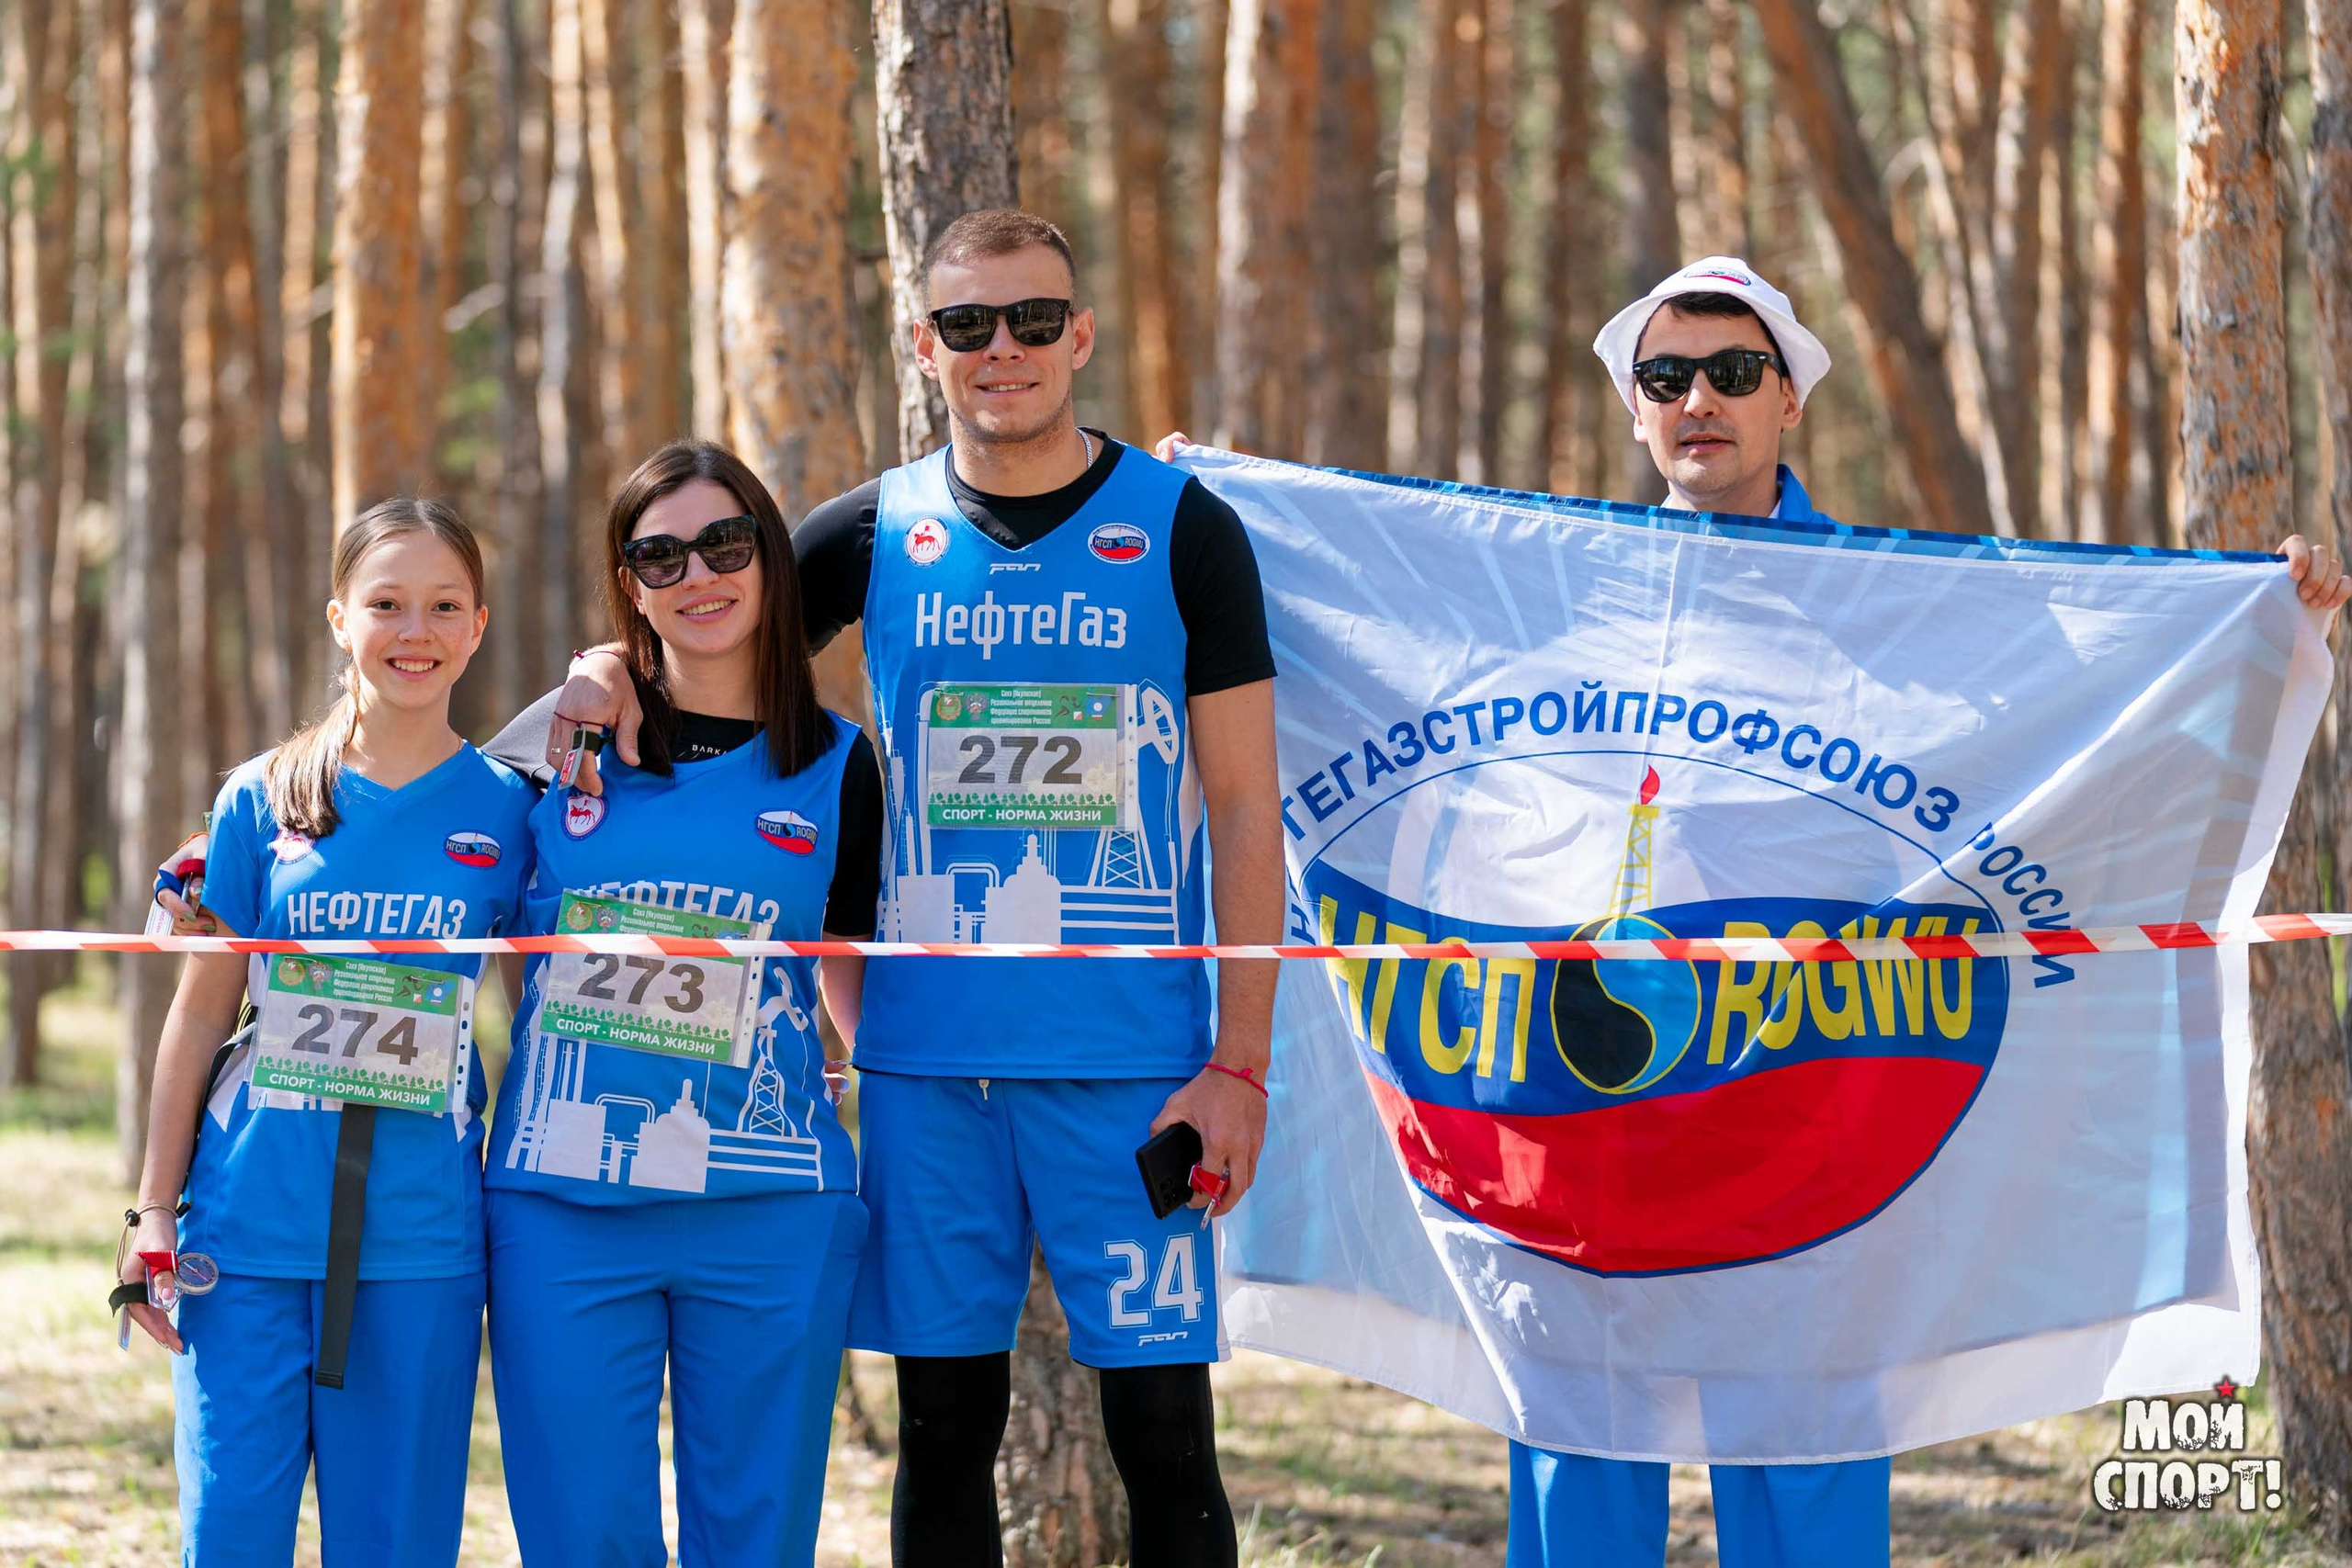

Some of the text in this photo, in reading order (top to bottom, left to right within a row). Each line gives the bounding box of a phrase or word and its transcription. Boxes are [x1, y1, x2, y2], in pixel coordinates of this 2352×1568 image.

[1095, 537, 1113, 549] НГСП
[915, 591, 1127, 660] НефтеГаз
[958, 735, 1082, 784] 272
[757, 818, 781, 835] НГСП
[943, 808, 986, 820] СПОРТ
[995, 808, 1046, 820] НОРМА
[1049, 809, 1102, 821] ЖИЗНИ
[446, 840, 467, 853] НГСП
[288, 891, 467, 939] НЕФТЕГАЗ
[577, 953, 705, 1013] 273
[1319, 894, 1980, 1082] НГСП ROGWU
[291, 1004, 419, 1066] 274
[556, 1018, 601, 1036] СПОРТ
[609, 1027, 662, 1046] НОРМА
[663, 1036, 716, 1055] ЖИЗНИ
[269, 1073, 315, 1089] СПОРТ
[324, 1080, 376, 1099] НОРМА
[379, 1089, 431, 1106] ЖИЗНИ
[1103, 1233, 1204, 1329] 24
